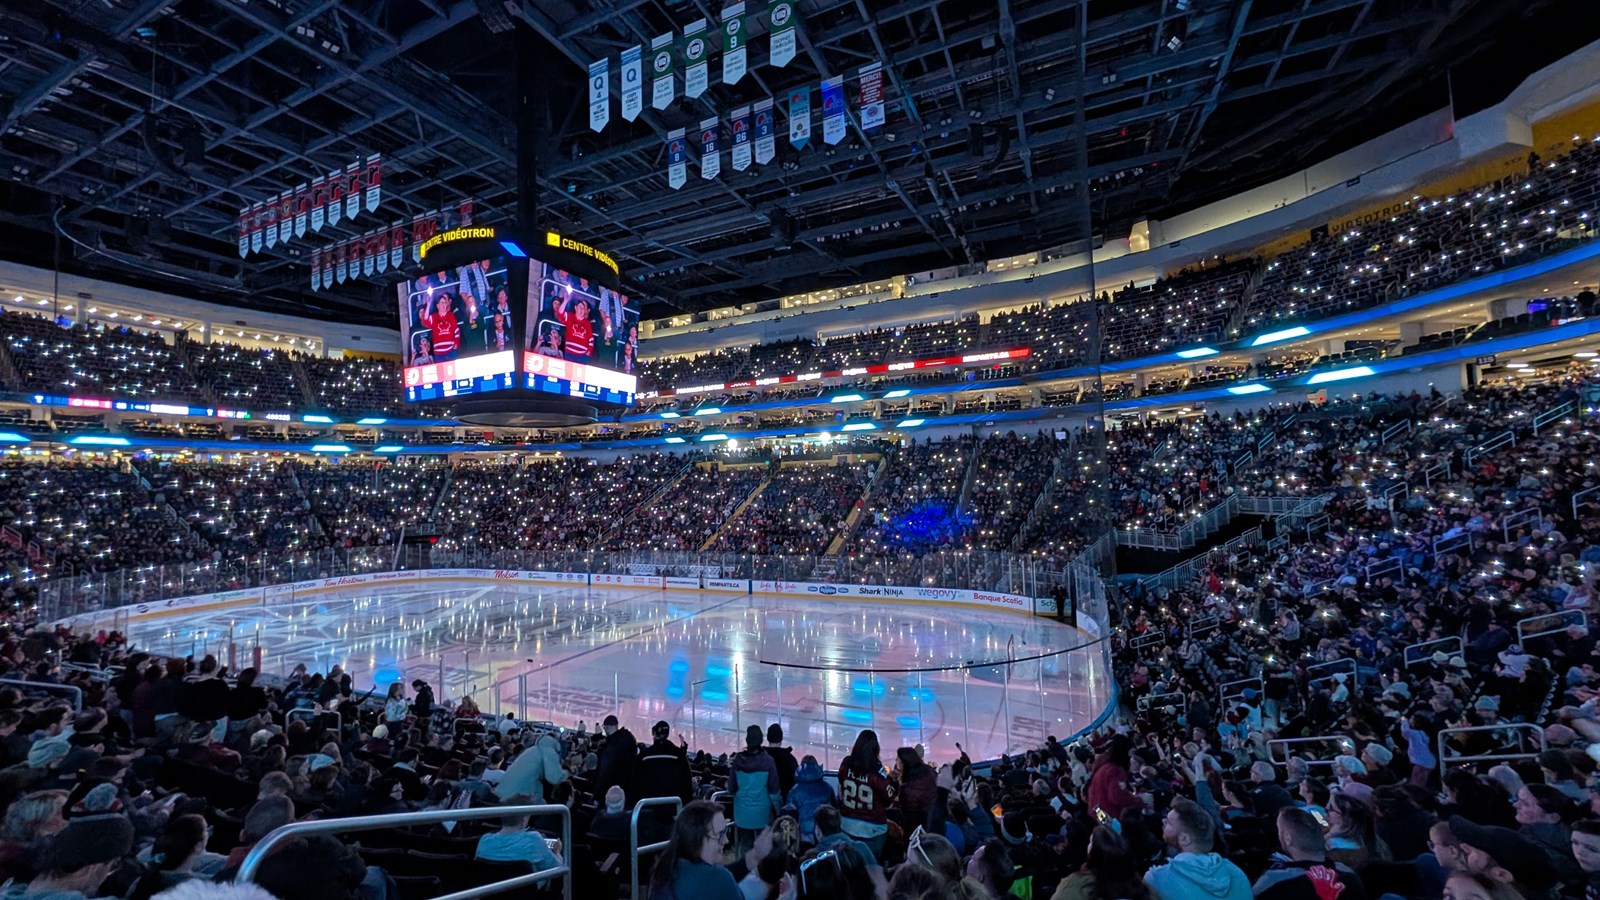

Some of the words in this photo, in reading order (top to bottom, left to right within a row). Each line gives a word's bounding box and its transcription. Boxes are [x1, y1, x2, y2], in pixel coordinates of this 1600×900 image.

[730, 36, 738, 49] 9
[626, 68, 637, 82] Q
[593, 76, 604, 90] Q
[761, 125, 768, 135] 3
[443, 227, 494, 242] VIDÉOTRON
[562, 238, 594, 257] CENTRE
[493, 569, 519, 579] Molson
[323, 579, 337, 587] Tim
[337, 577, 367, 586] Hortons
[859, 587, 882, 596] Shark
[883, 587, 904, 597] NINJA
[917, 588, 957, 600] wegovy
[973, 592, 1001, 603] Banque
[1002, 596, 1023, 606] Scotia
[843, 779, 873, 810] 29
